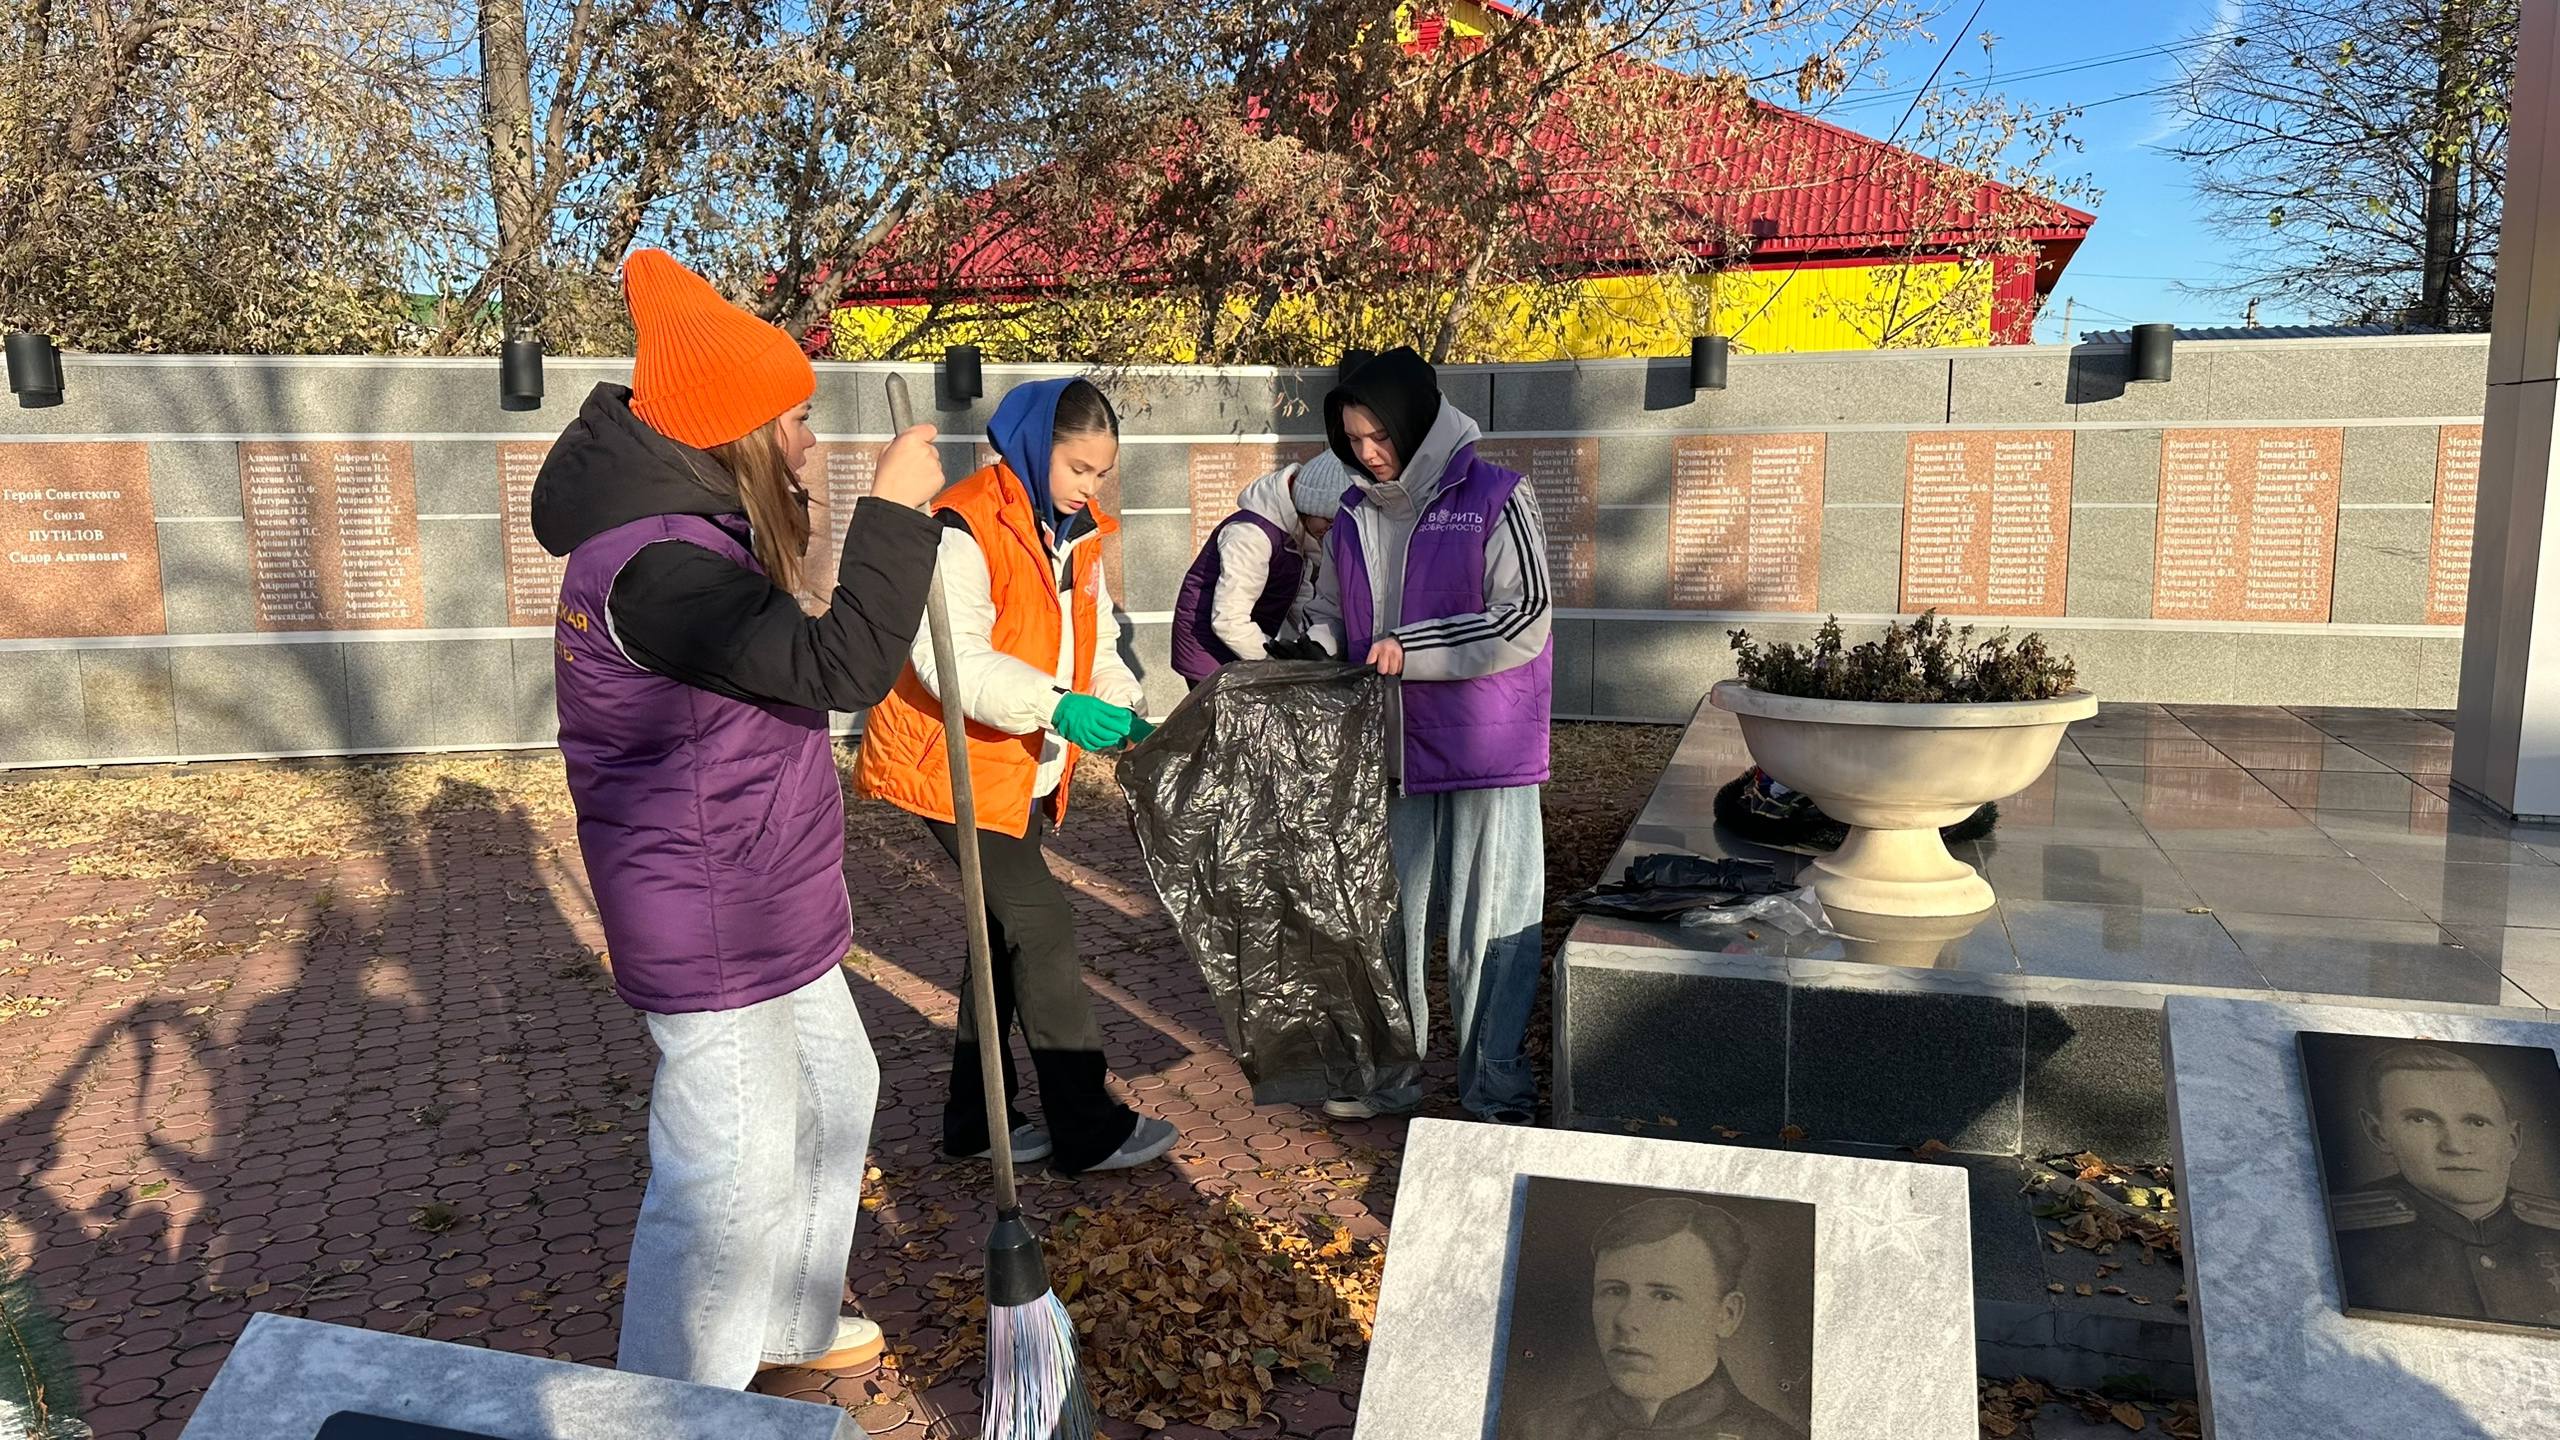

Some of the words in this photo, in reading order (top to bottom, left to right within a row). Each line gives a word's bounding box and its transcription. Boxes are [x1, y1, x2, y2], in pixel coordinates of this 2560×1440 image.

[247, 454, 289, 463] Адамович
[250, 487, 295, 495] Афанасьев
[336, 486, 369, 495] Андреев
[3, 489, 42, 503] Герой
[45, 489, 121, 500] Советского
[252, 497, 289, 506] Абатуров
[43, 510, 86, 520] Союза
[337, 507, 382, 516] Артамонов
[254, 518, 287, 526] Аксенов
[28, 529, 104, 542] ПУТИЛОВ
[255, 529, 300, 538] Артамонов
[339, 528, 373, 536] Аксенов
[9, 550, 51, 565] Сидор
[56, 551, 128, 563] Антонович
[341, 549, 394, 557] Александров
[258, 571, 296, 580] Алексеев
[345, 601, 388, 610] Афанасьев
[516, 607, 548, 616] Батурин
[262, 613, 315, 621] Александров
